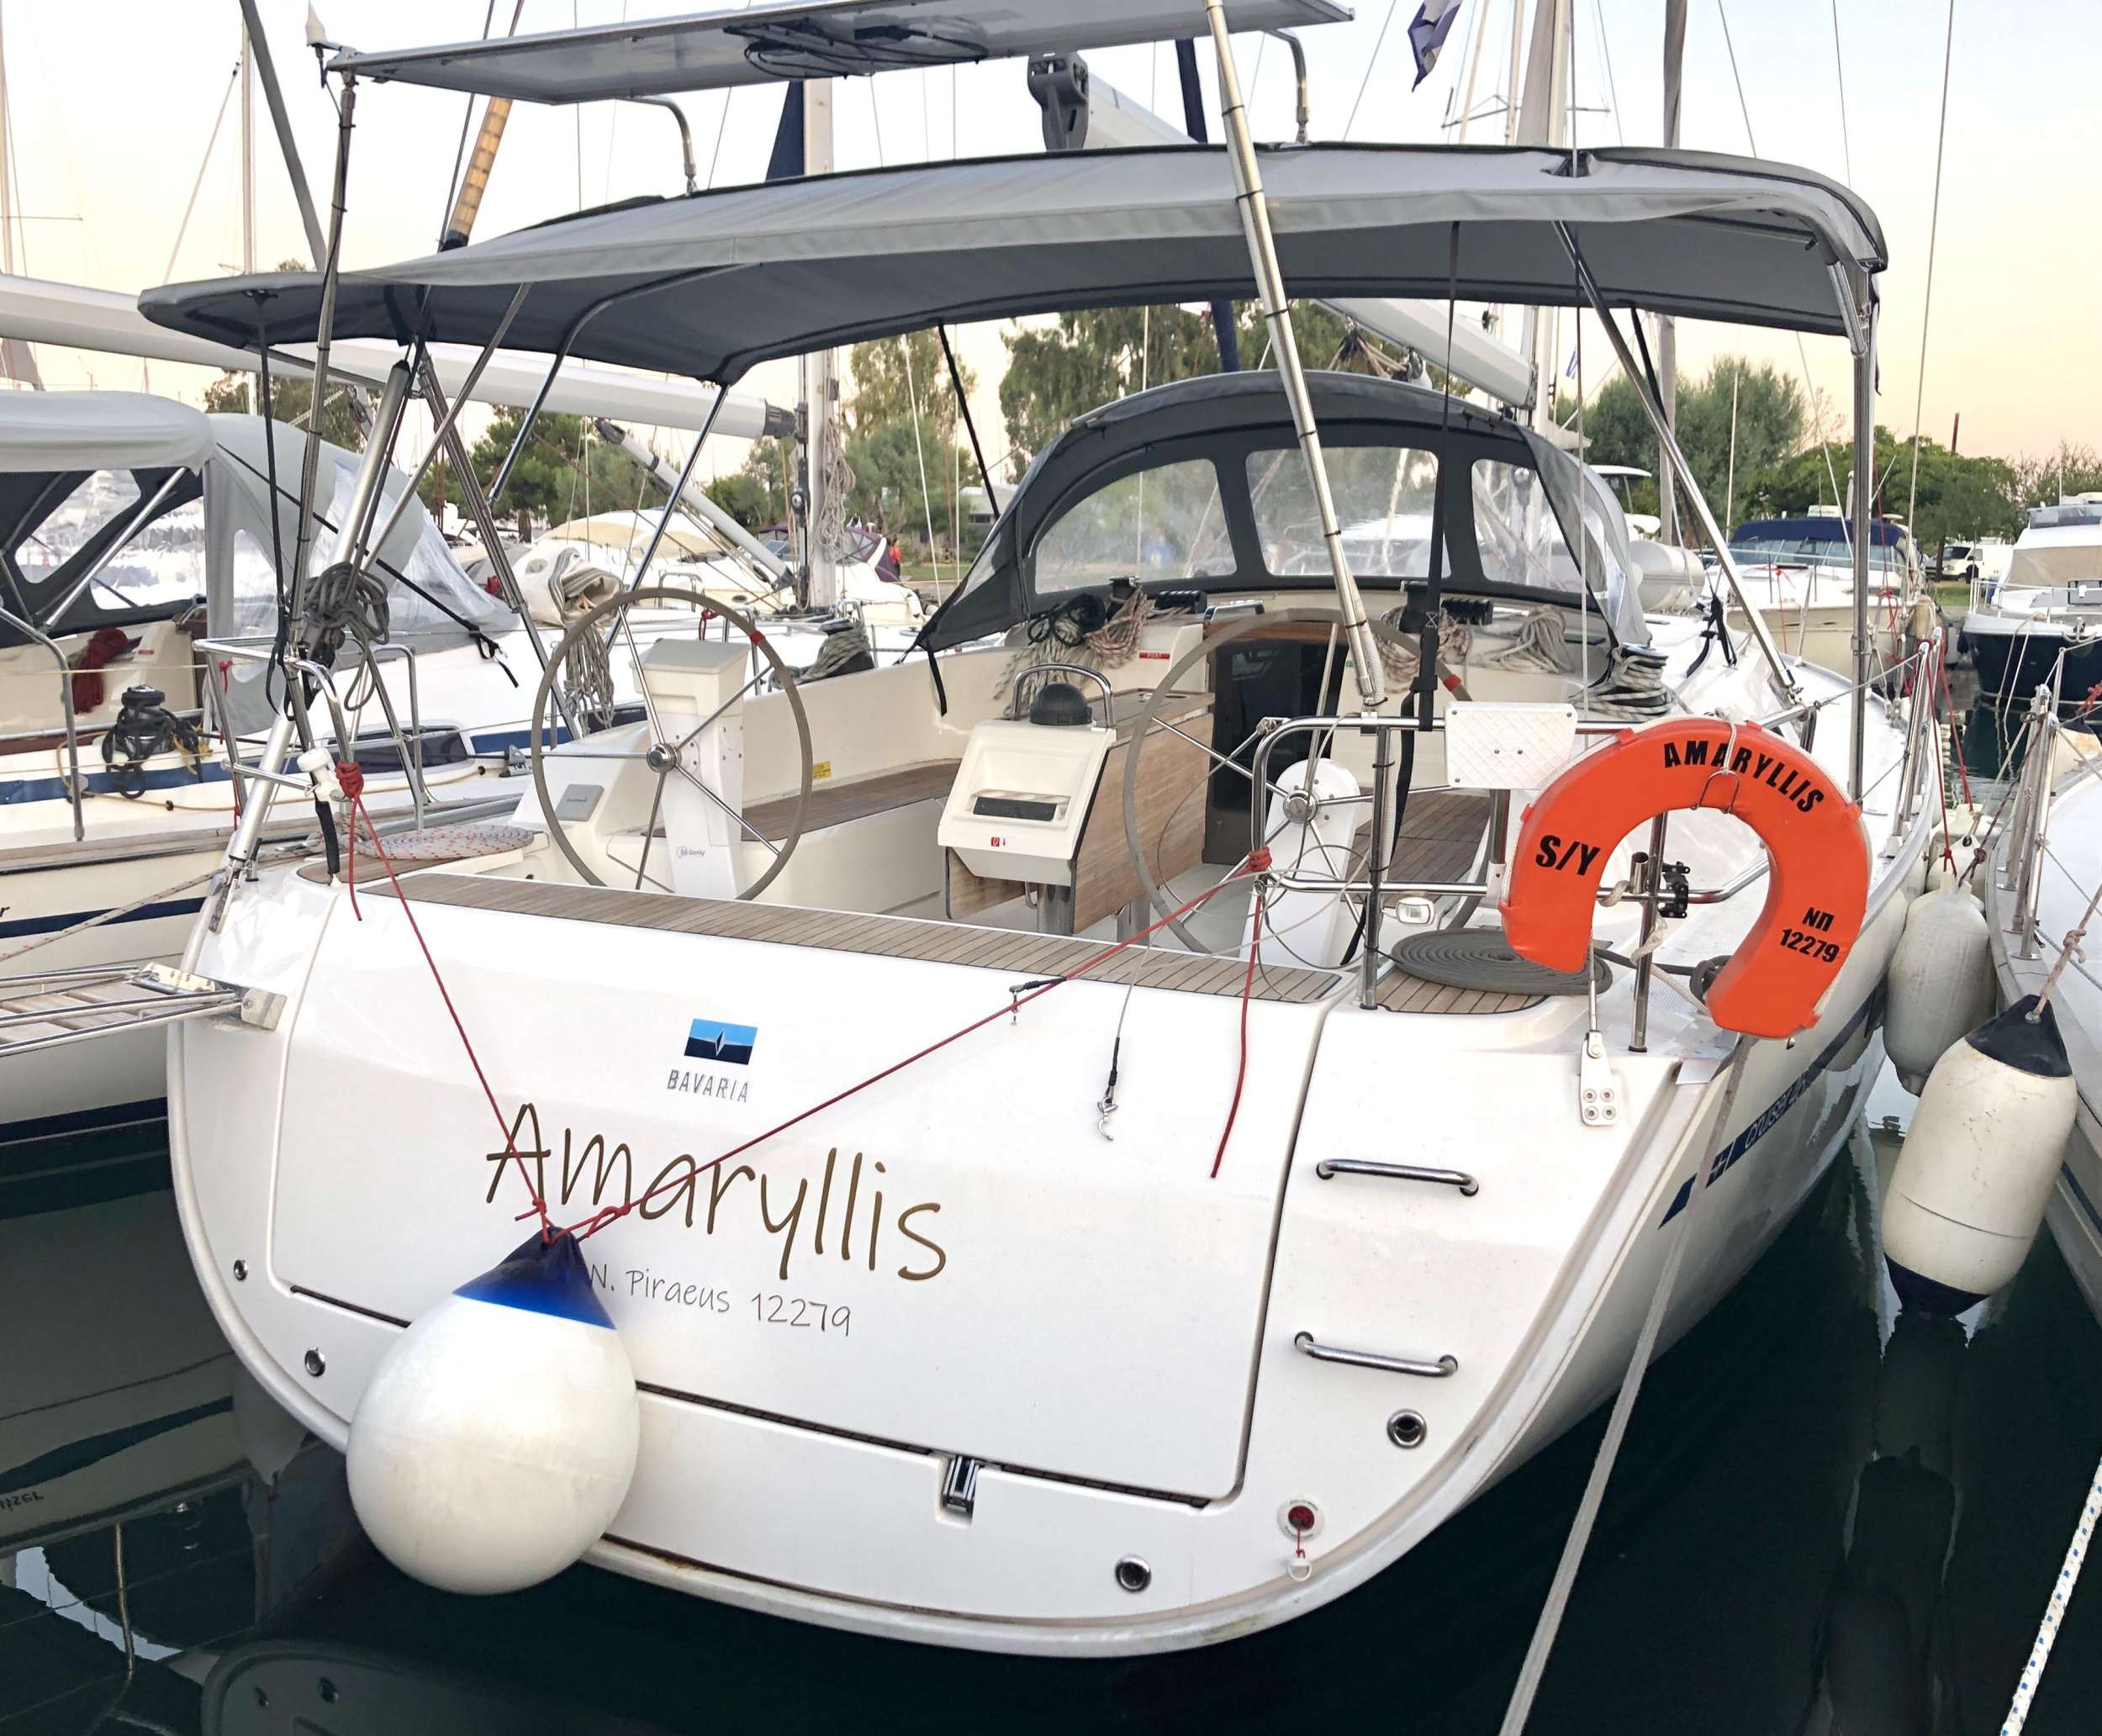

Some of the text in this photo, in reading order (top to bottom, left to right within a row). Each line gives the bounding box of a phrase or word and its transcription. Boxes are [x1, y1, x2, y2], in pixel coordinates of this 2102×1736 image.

[1664, 740, 1825, 813] AMARYLLIS
[1535, 834, 1601, 877] S/Y
[1779, 928, 1841, 963] 12279
[667, 1069, 750, 1103] BAVARIA
[486, 1102, 947, 1281] Amaryllis
[626, 1268, 731, 1313] Piraeus
[751, 1292, 852, 1338] 12279
